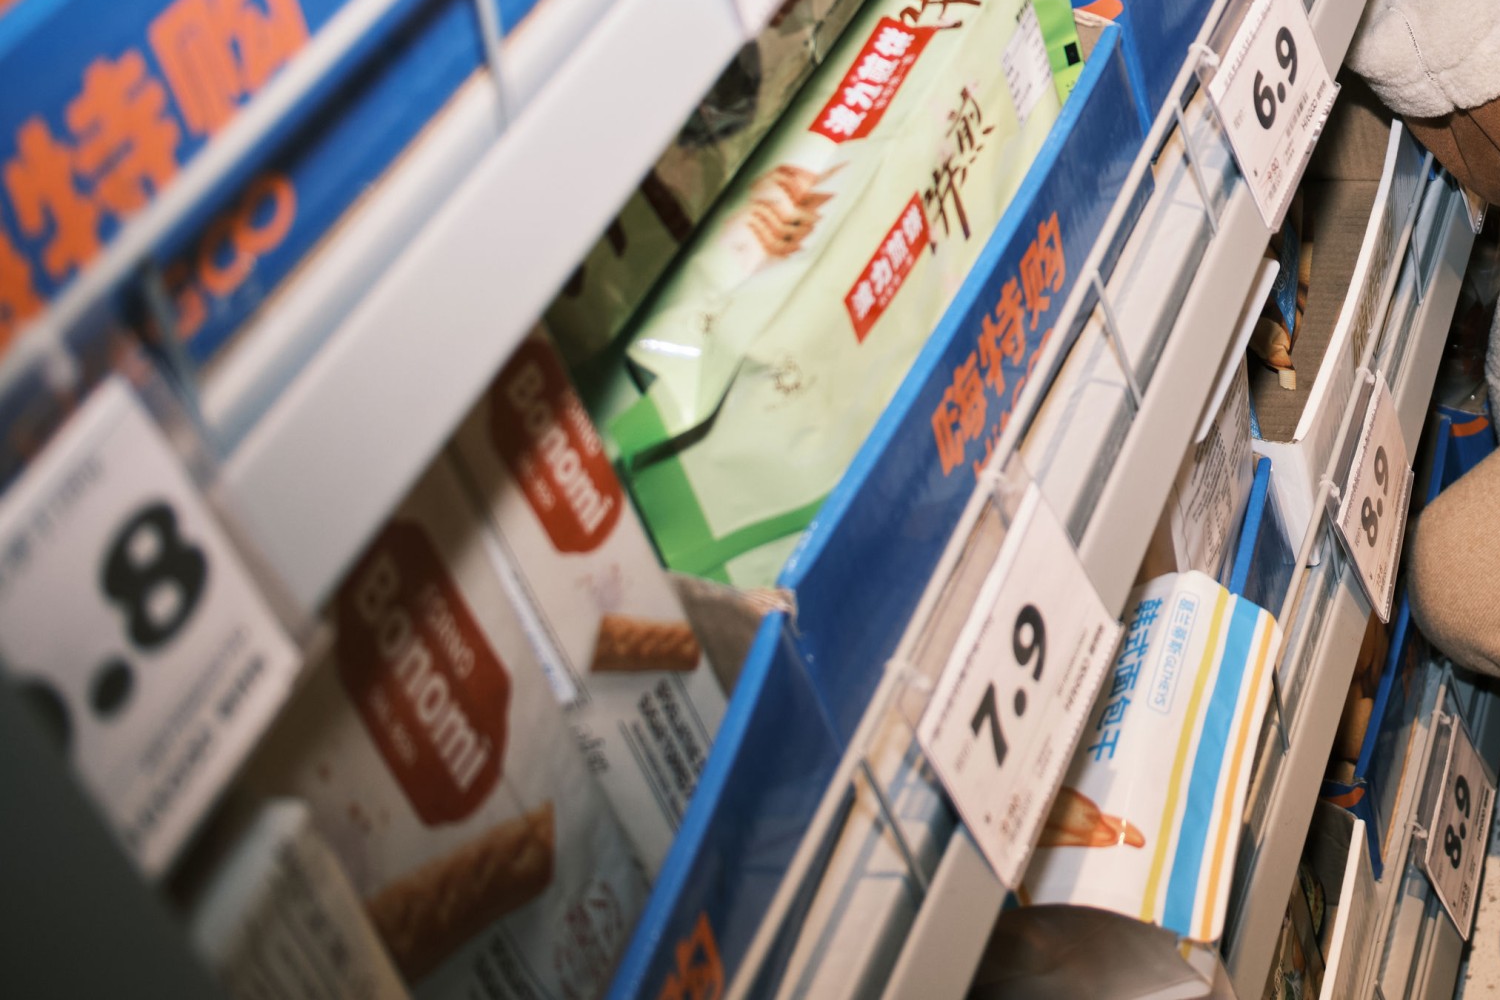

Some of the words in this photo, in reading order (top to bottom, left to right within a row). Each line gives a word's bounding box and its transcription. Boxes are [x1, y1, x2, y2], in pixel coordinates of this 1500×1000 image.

[1253, 26, 1298, 130] 6.9
[931, 210, 1066, 477] 嗨特购
[1360, 445, 1389, 548] 8.9
[351, 550, 492, 792] Bonomi
[970, 603, 1046, 768] 7.9
[1444, 774, 1471, 870] 8.9
